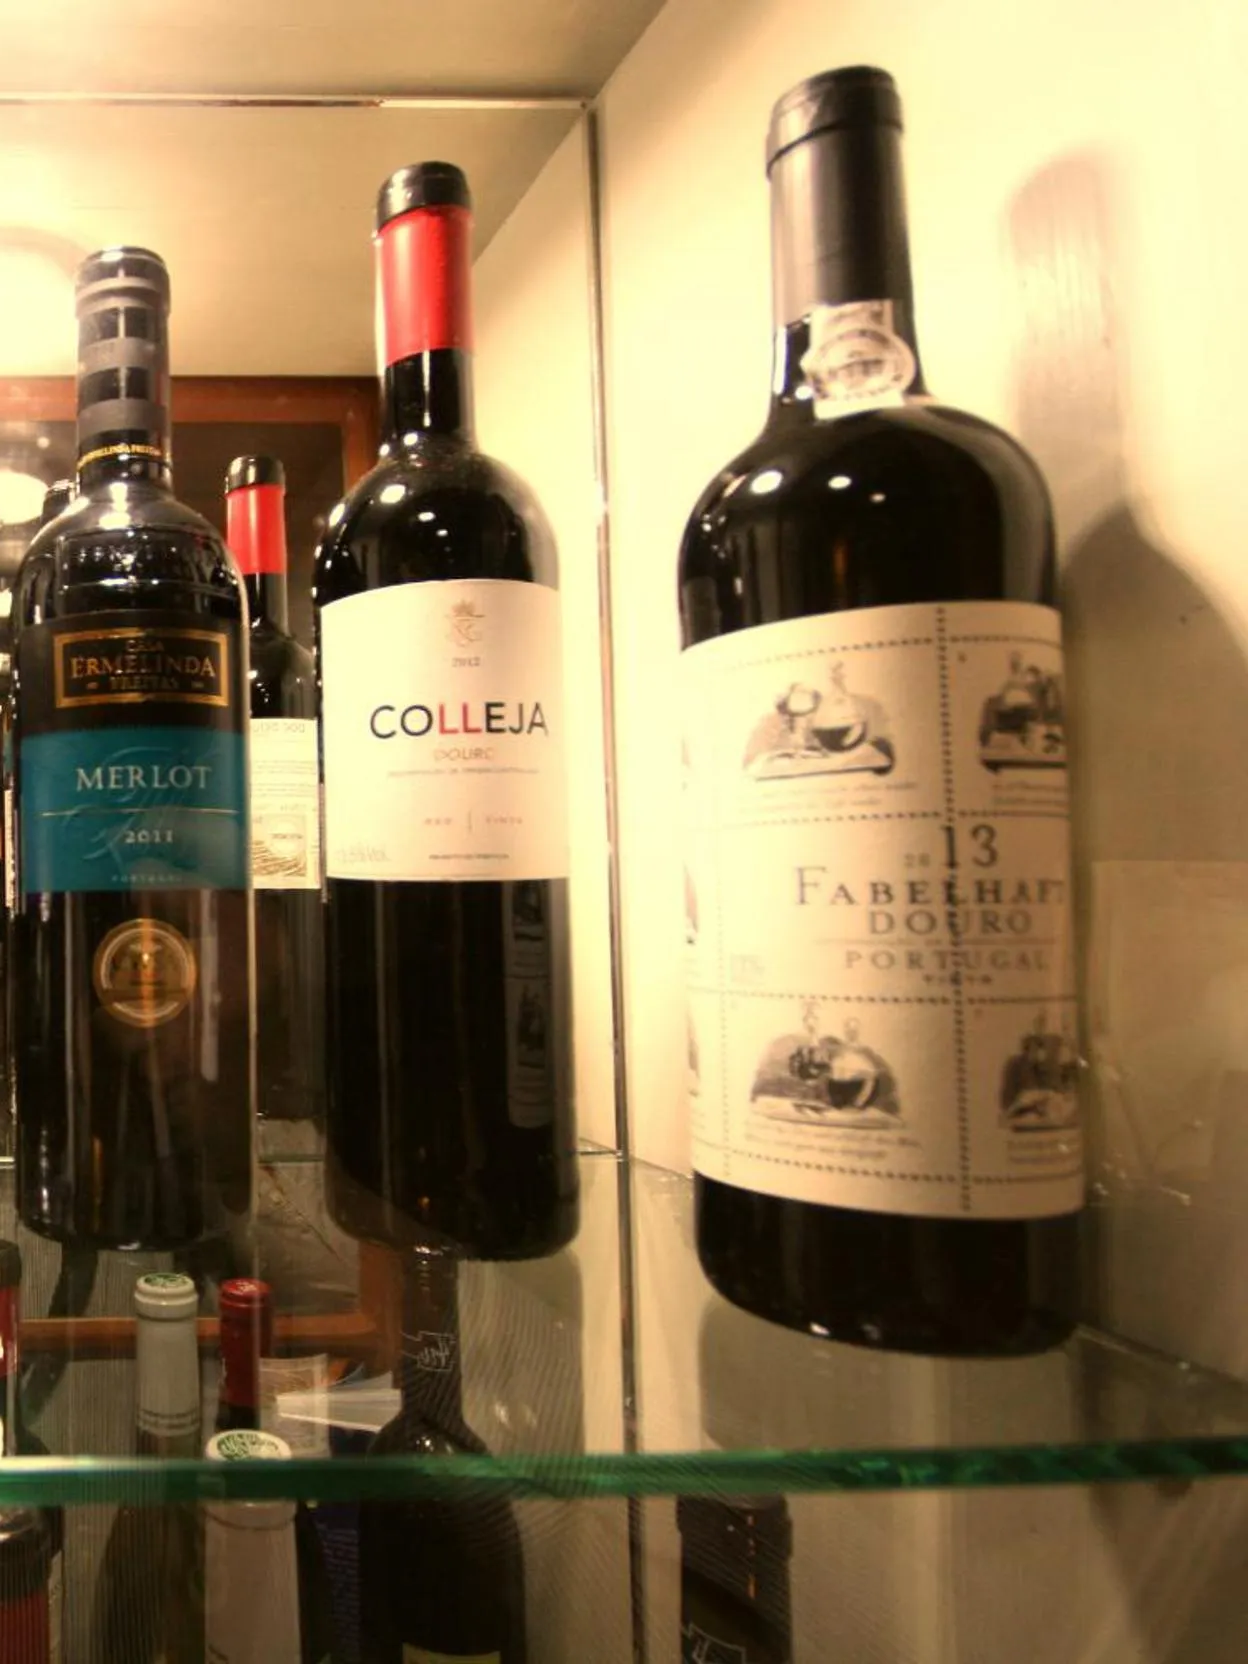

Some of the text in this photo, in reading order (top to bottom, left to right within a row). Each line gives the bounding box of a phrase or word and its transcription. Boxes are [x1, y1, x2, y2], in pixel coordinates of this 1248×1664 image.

[70, 653, 217, 679] ERMELINDA
[369, 702, 550, 740] COLLEJA
[75, 764, 212, 792] MERLOT
[124, 829, 174, 844] 2011
[940, 823, 999, 869] 13
[869, 910, 1034, 935] DOURO
[844, 950, 1050, 971] PORTUGAL
